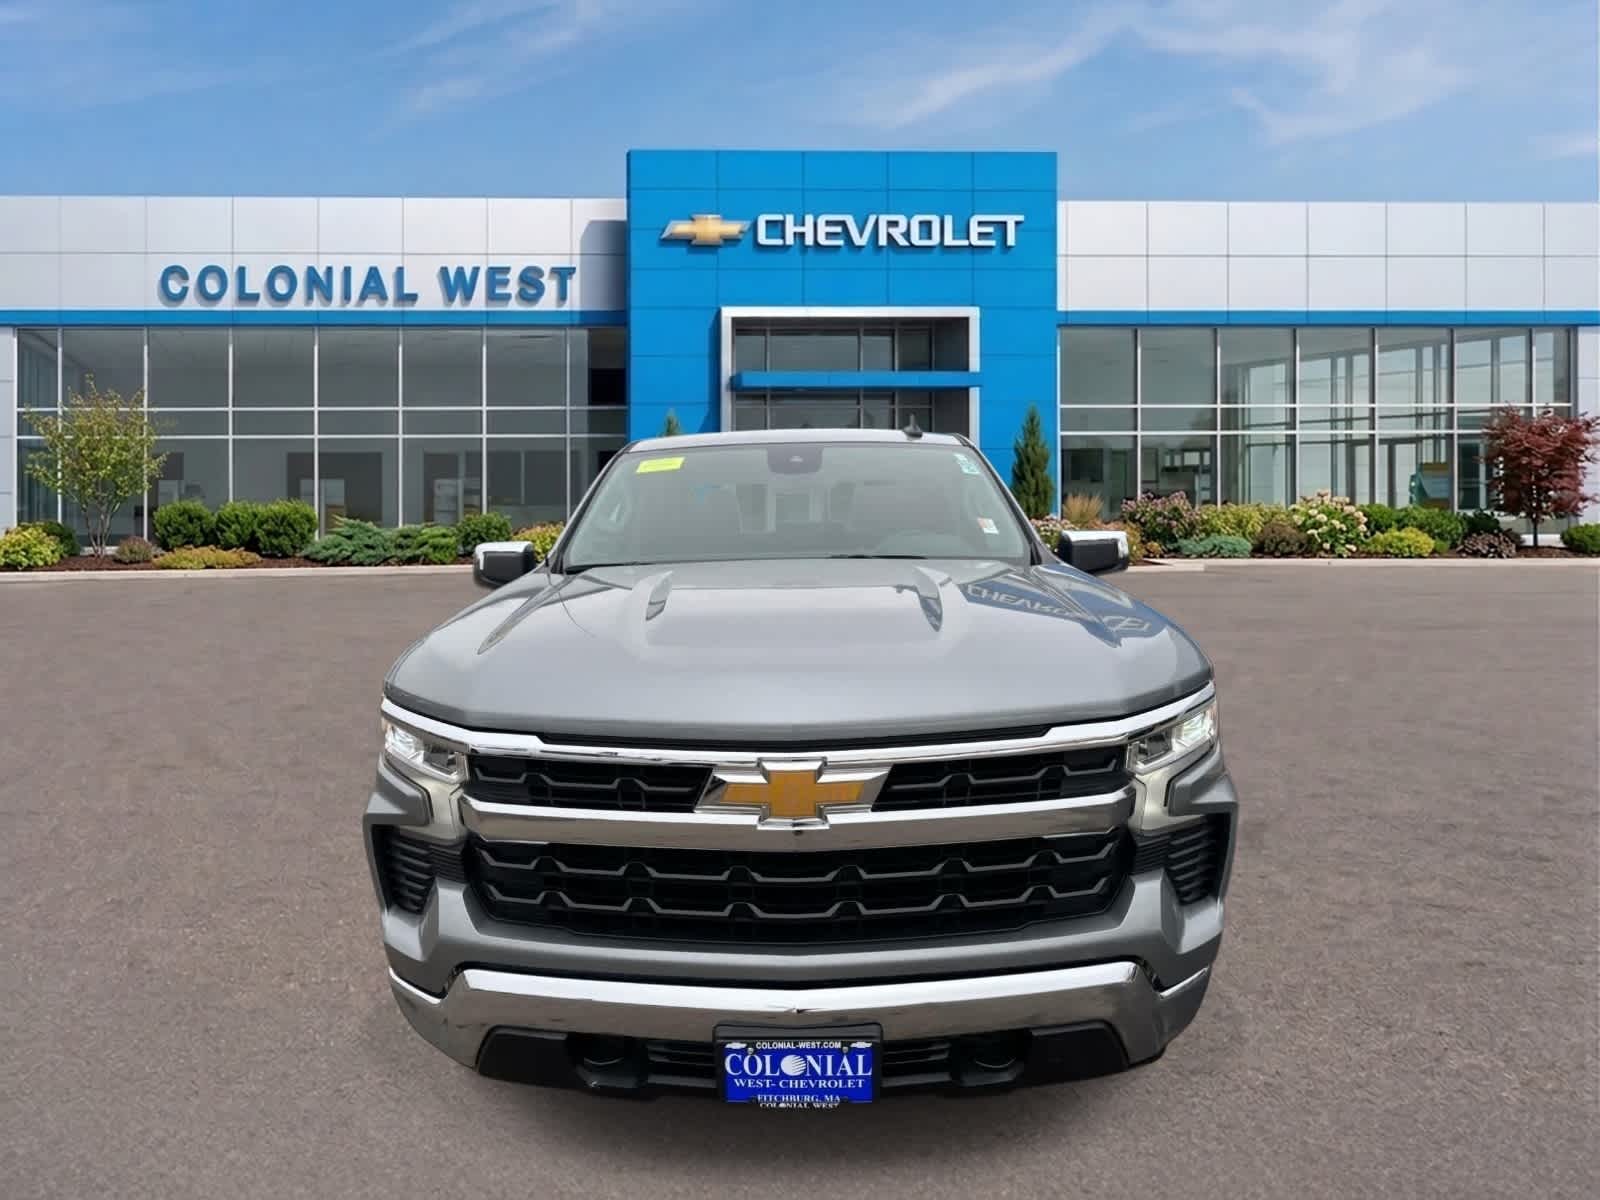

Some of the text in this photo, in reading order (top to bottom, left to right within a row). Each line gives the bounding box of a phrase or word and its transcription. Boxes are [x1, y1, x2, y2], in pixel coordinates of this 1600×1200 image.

[757, 214, 1024, 246] CHEVROLET
[160, 264, 576, 303] COLONIAL WEST
[755, 1041, 841, 1049] COLONIAL-WEST.COM
[725, 1053, 872, 1076] COLONIAL
[779, 1079, 865, 1088] CHEVROLET
[824, 1094, 841, 1102] MA
